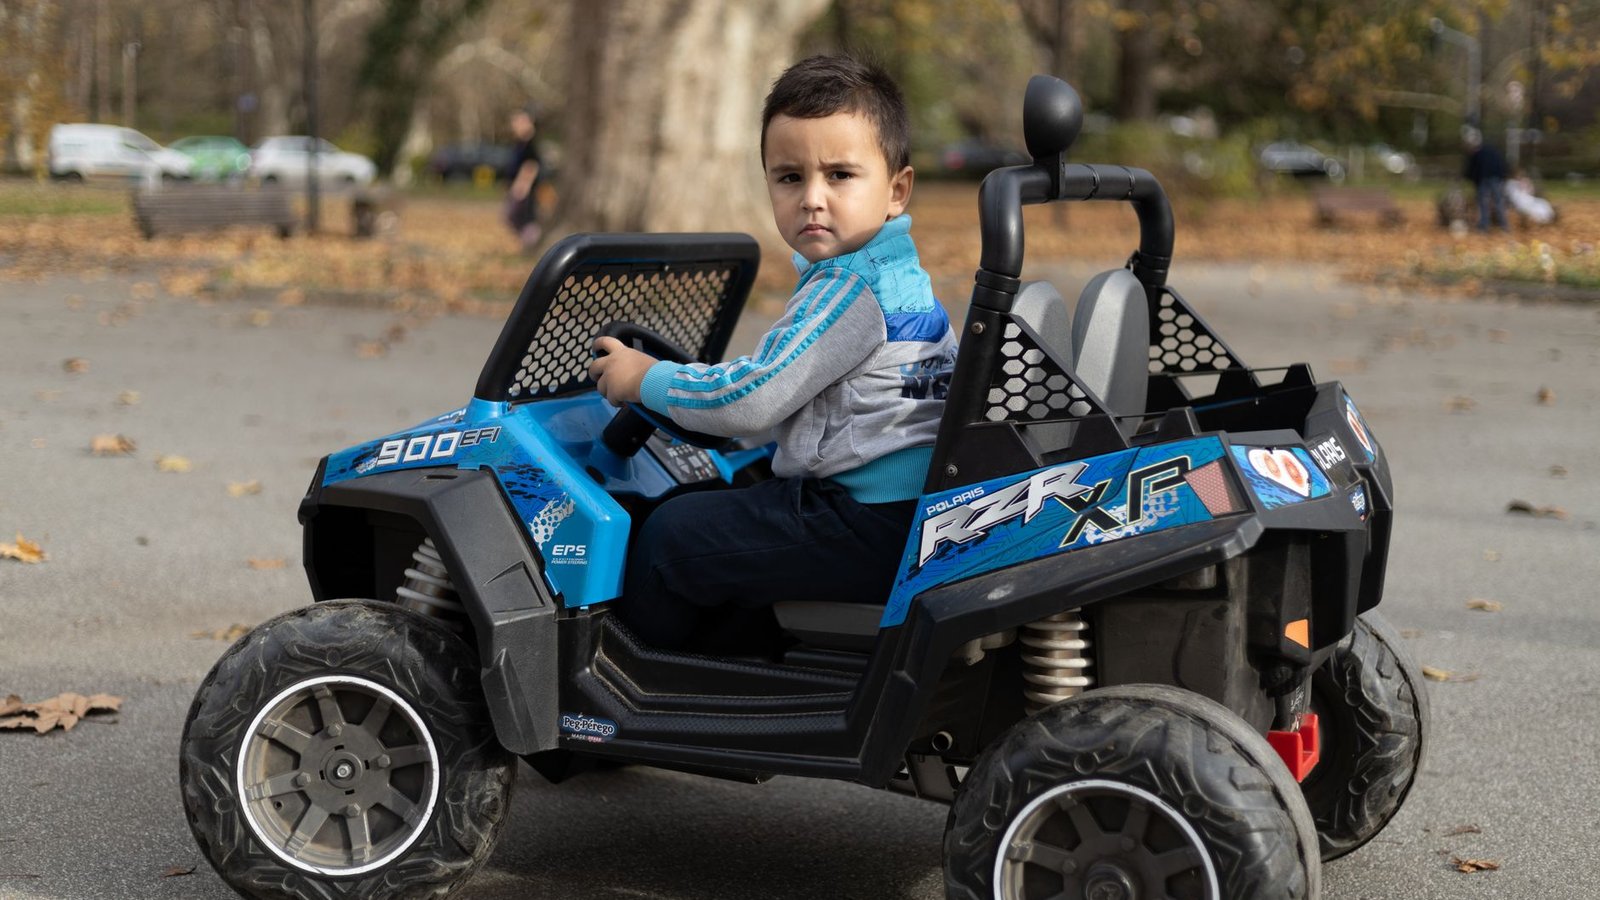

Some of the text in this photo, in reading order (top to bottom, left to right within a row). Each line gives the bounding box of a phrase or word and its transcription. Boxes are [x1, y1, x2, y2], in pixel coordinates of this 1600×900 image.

[377, 426, 502, 466] 900 EFI
[919, 455, 1191, 568] RZR XP
[926, 487, 985, 516] POLARIS
[552, 544, 587, 556] EPS
